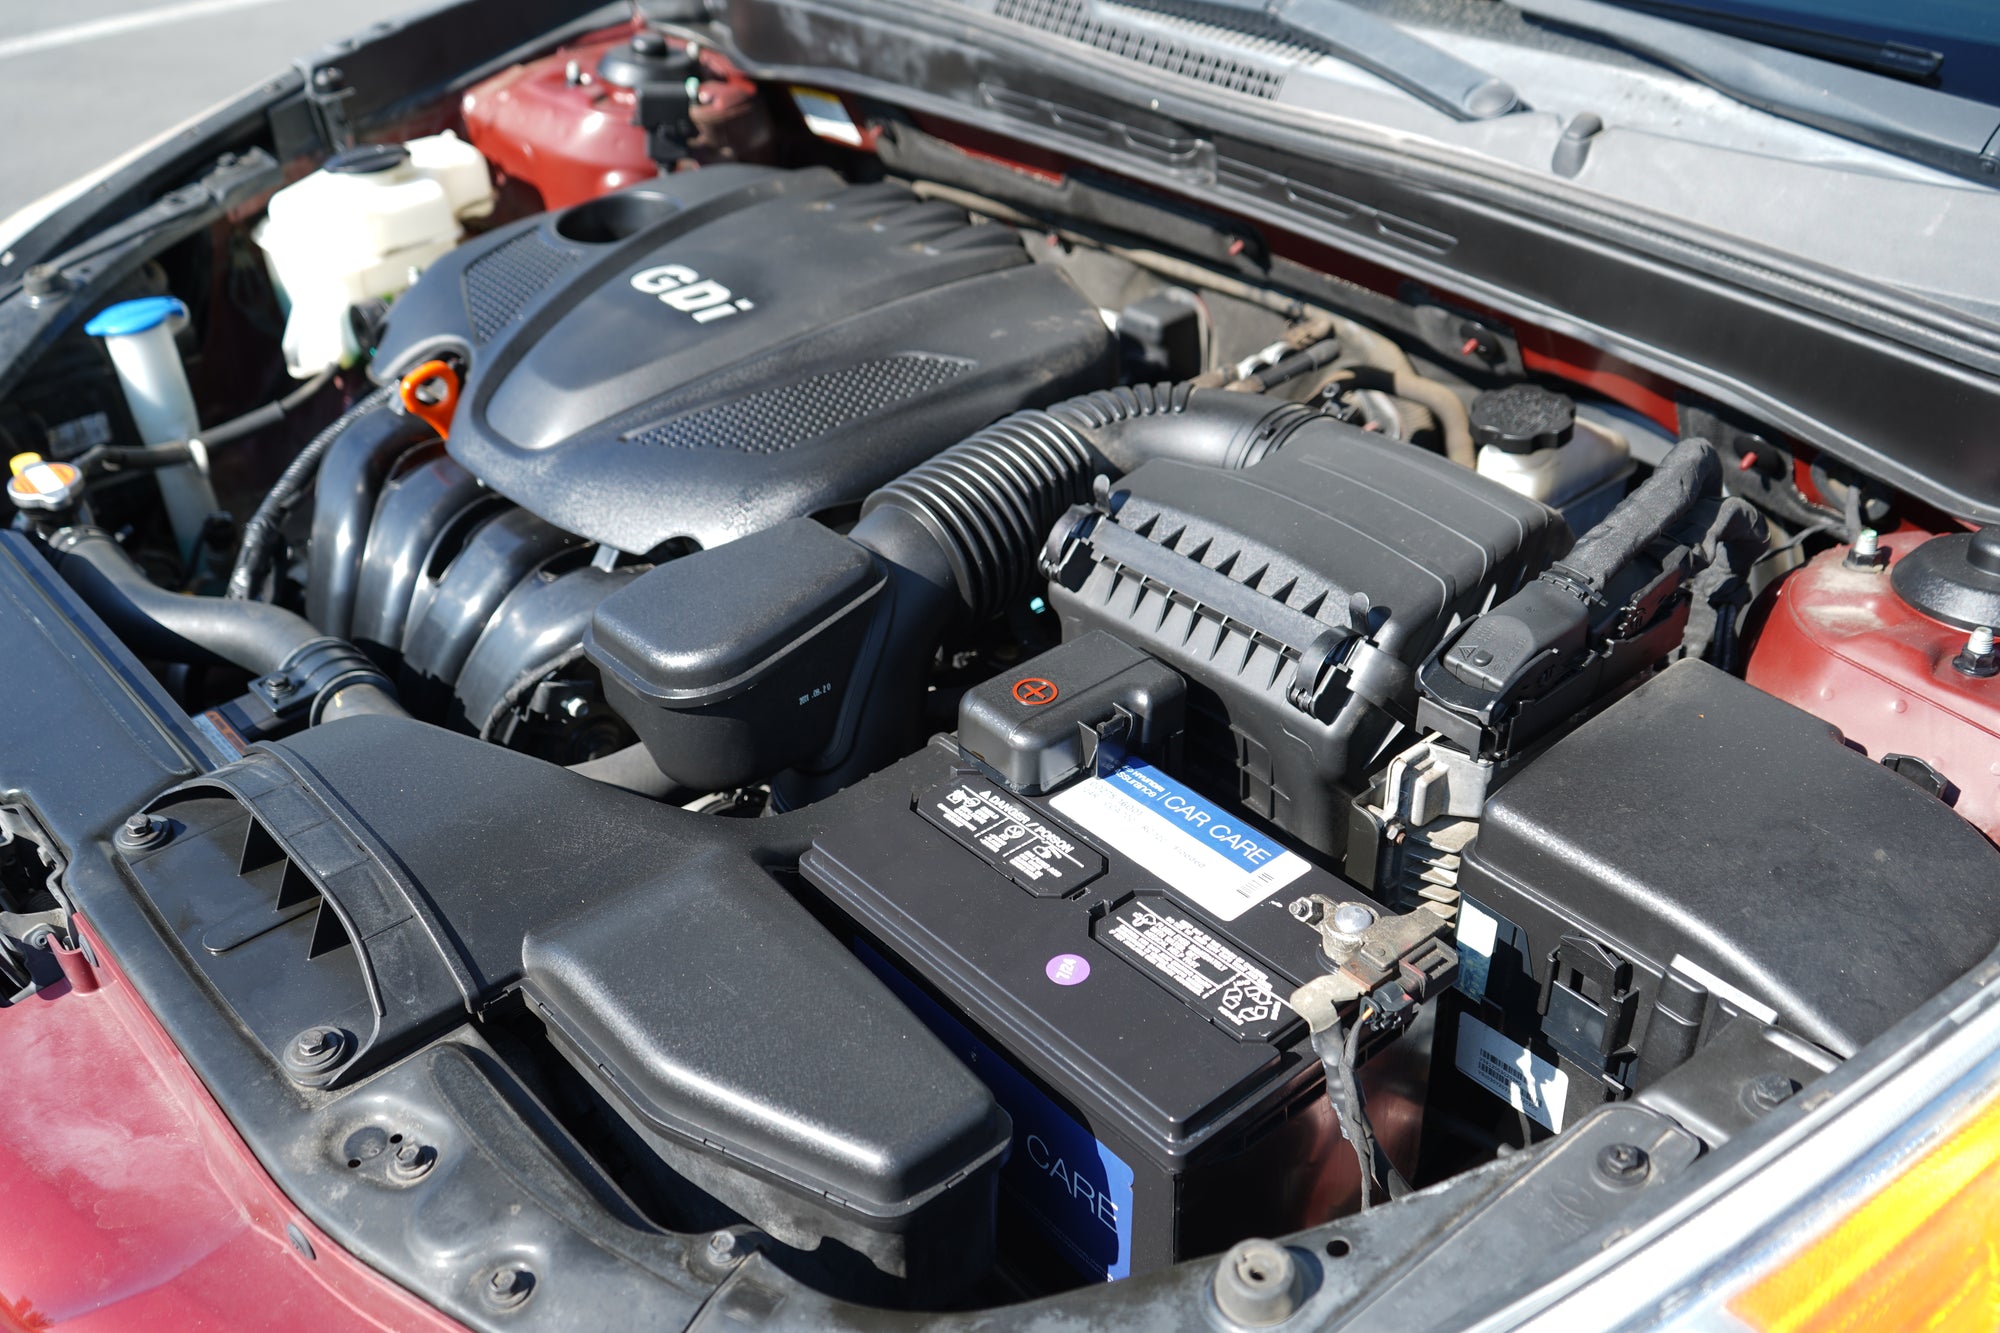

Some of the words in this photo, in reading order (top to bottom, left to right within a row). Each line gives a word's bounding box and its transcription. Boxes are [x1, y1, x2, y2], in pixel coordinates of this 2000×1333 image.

[630, 264, 754, 324] GDi
[988, 796, 1031, 823] DANGER
[1034, 825, 1075, 853] POISON
[1164, 795, 1211, 828] CAR
[1209, 824, 1272, 865] CARE
[1026, 1134, 1119, 1233] CARE
